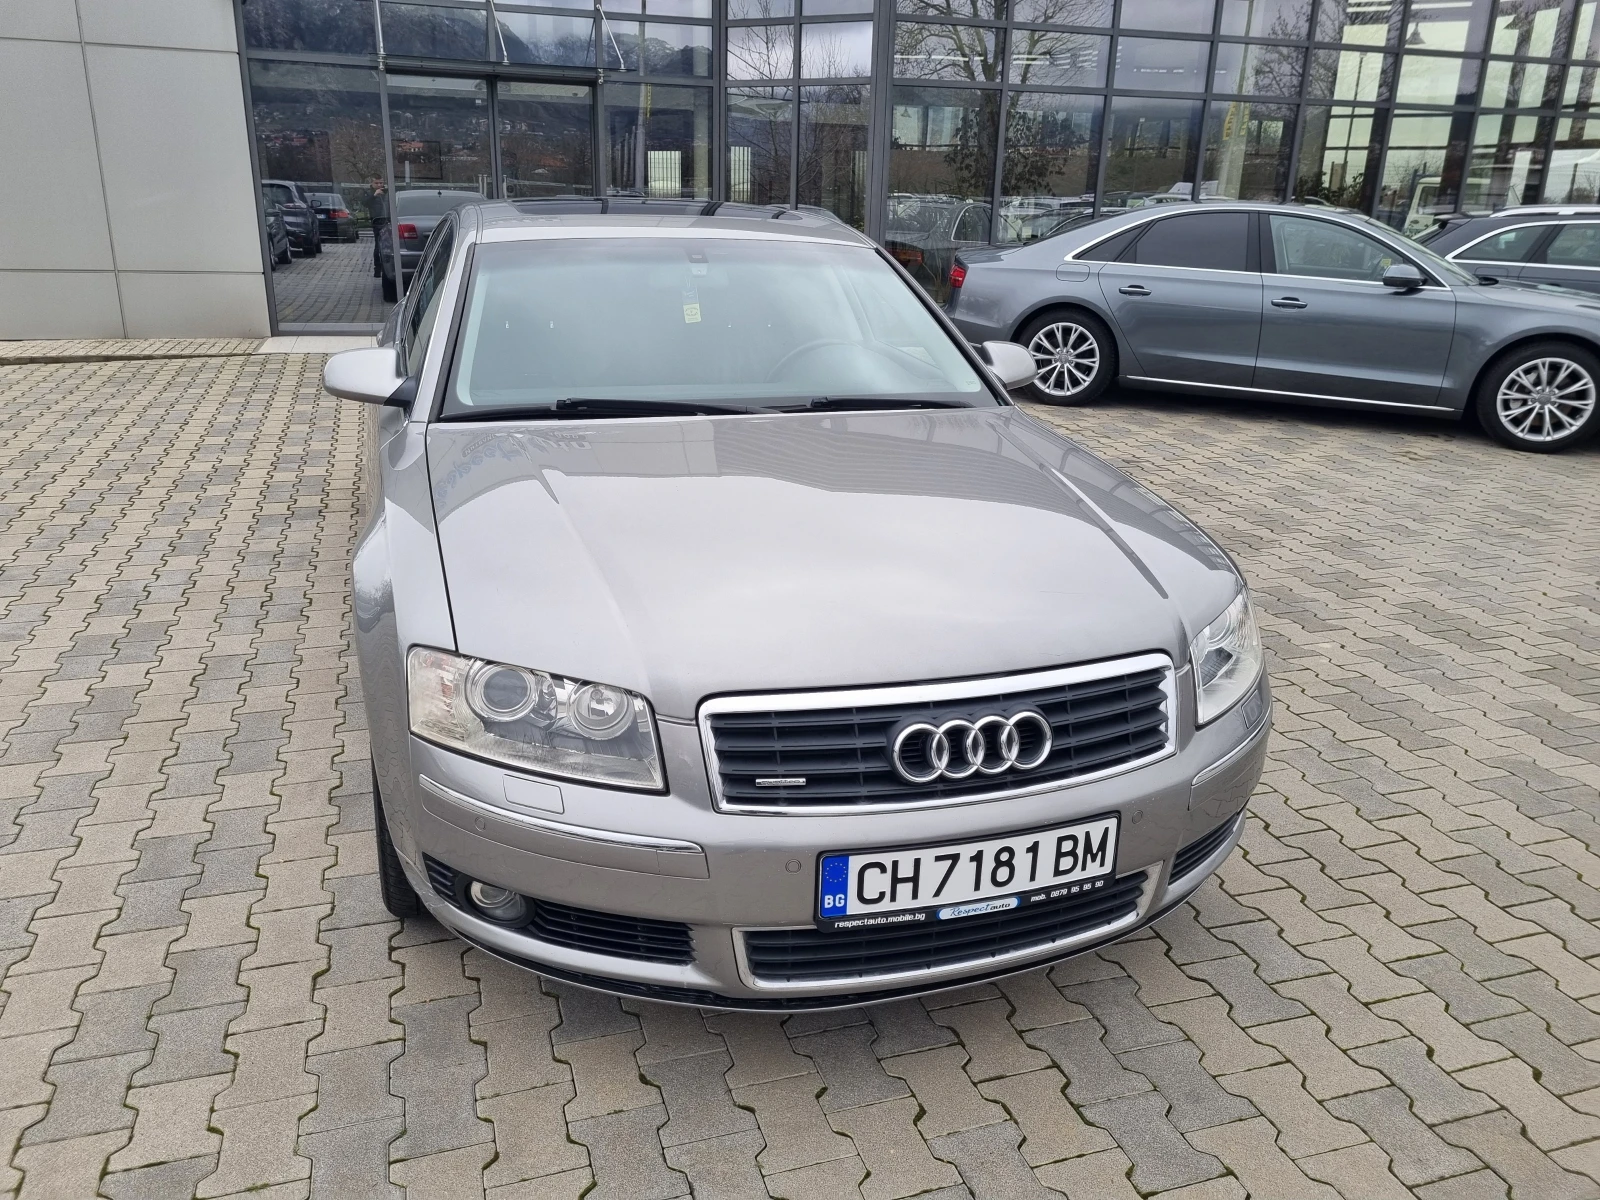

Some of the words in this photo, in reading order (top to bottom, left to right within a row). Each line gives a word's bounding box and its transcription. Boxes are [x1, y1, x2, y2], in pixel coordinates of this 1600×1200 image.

[856, 857, 922, 905] CH
[932, 840, 1040, 897] 7181
[1052, 826, 1110, 878] BM
[1050, 888, 1068, 898] 0879
[1070, 885, 1080, 894] 95
[1082, 882, 1092, 891] 95
[824, 893, 845, 909] BG
[834, 913, 926, 928] respectauto.mobile.bg
